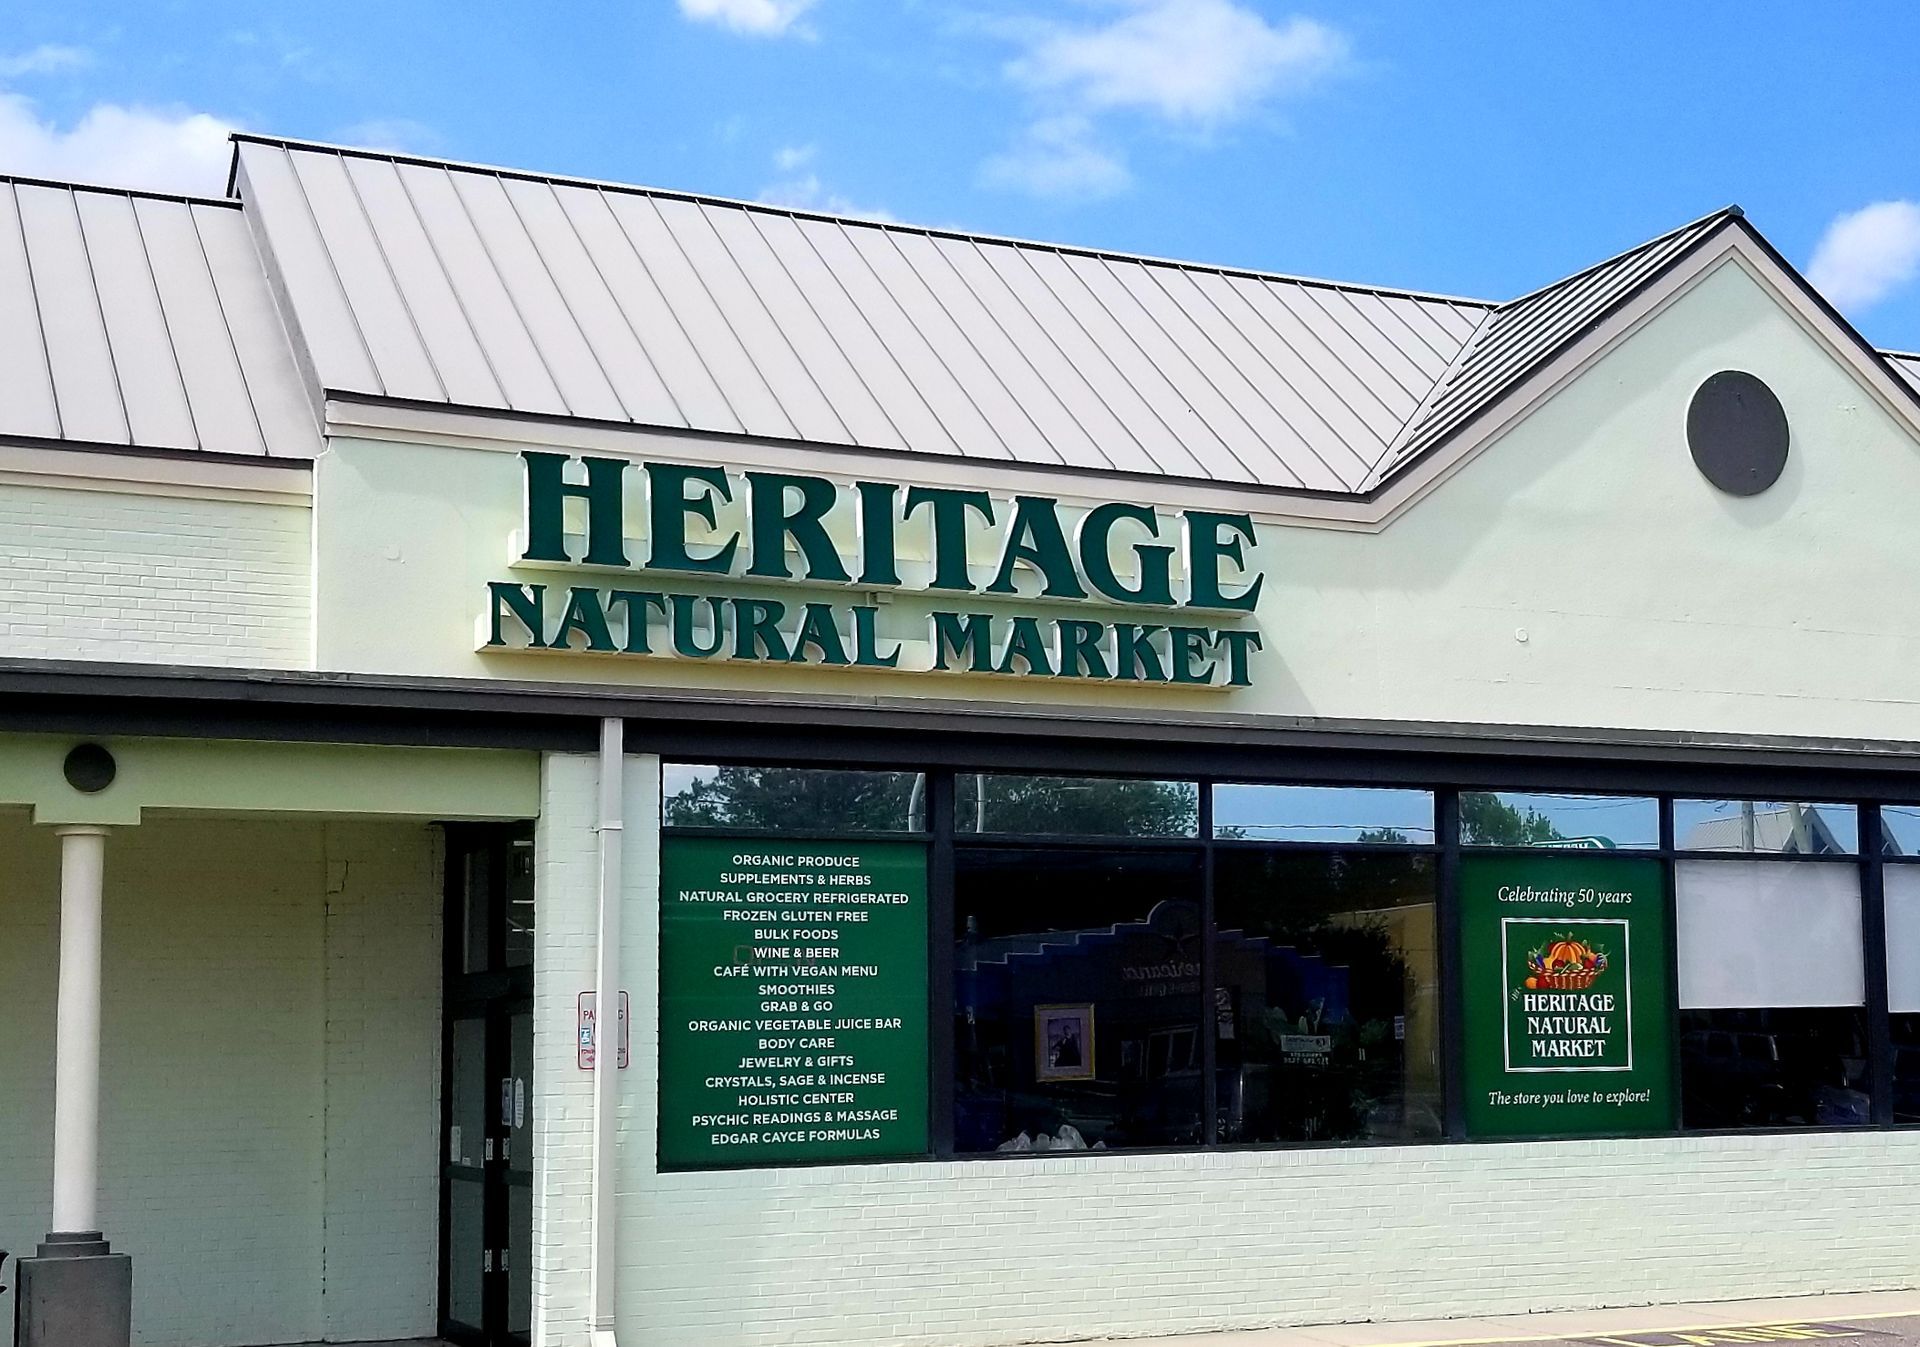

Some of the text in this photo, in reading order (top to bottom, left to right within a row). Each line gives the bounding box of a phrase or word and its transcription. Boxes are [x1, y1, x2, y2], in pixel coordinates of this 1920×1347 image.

[522, 451, 1264, 612] HERITAGE
[487, 582, 1263, 687] NATURAL MARKET
[733, 855, 859, 867] ORGANIC PRODUCE
[721, 873, 871, 885] SUPPLEMENTS & HERBS
[680, 891, 908, 903] NATURAL GROCERY REFRIGERATED
[1498, 886, 1632, 907] Celebrating 50 years
[724, 910, 868, 921] FROZEN GLUTEN FREE
[755, 929, 838, 940] BULK FOODS
[754, 948, 790, 958] WINE
[795, 948, 802, 958] &
[806, 948, 839, 958] BEER
[714, 963, 877, 976] CAFÉ WITH VEGAN MENU
[759, 984, 835, 995] SMOOTHIES
[761, 1001, 832, 1011] GRAB & GO
[1524, 995, 1614, 1012] HERITAGE
[689, 1018, 901, 1031] ORGANIC VEGETABLE JUICE BAR
[1528, 1017, 1611, 1034] NATURAL
[759, 1038, 834, 1049] BODY CARE
[1532, 1040, 1605, 1057] MARKET
[739, 1056, 853, 1068] JEWELRY & GIFTS
[706, 1073, 885, 1088] CRYSTALS, SAGE & INCENSE
[739, 1093, 853, 1106] HOLISTIC CENTER
[1489, 1088, 1650, 1107] The store you love to explore!
[693, 1110, 897, 1126] PSYCHIC READINGS & MASSAGE
[712, 1129, 879, 1144] EDGAR CAYCE FORMULAS
[1595, 1324, 1865, 1347] LANE
